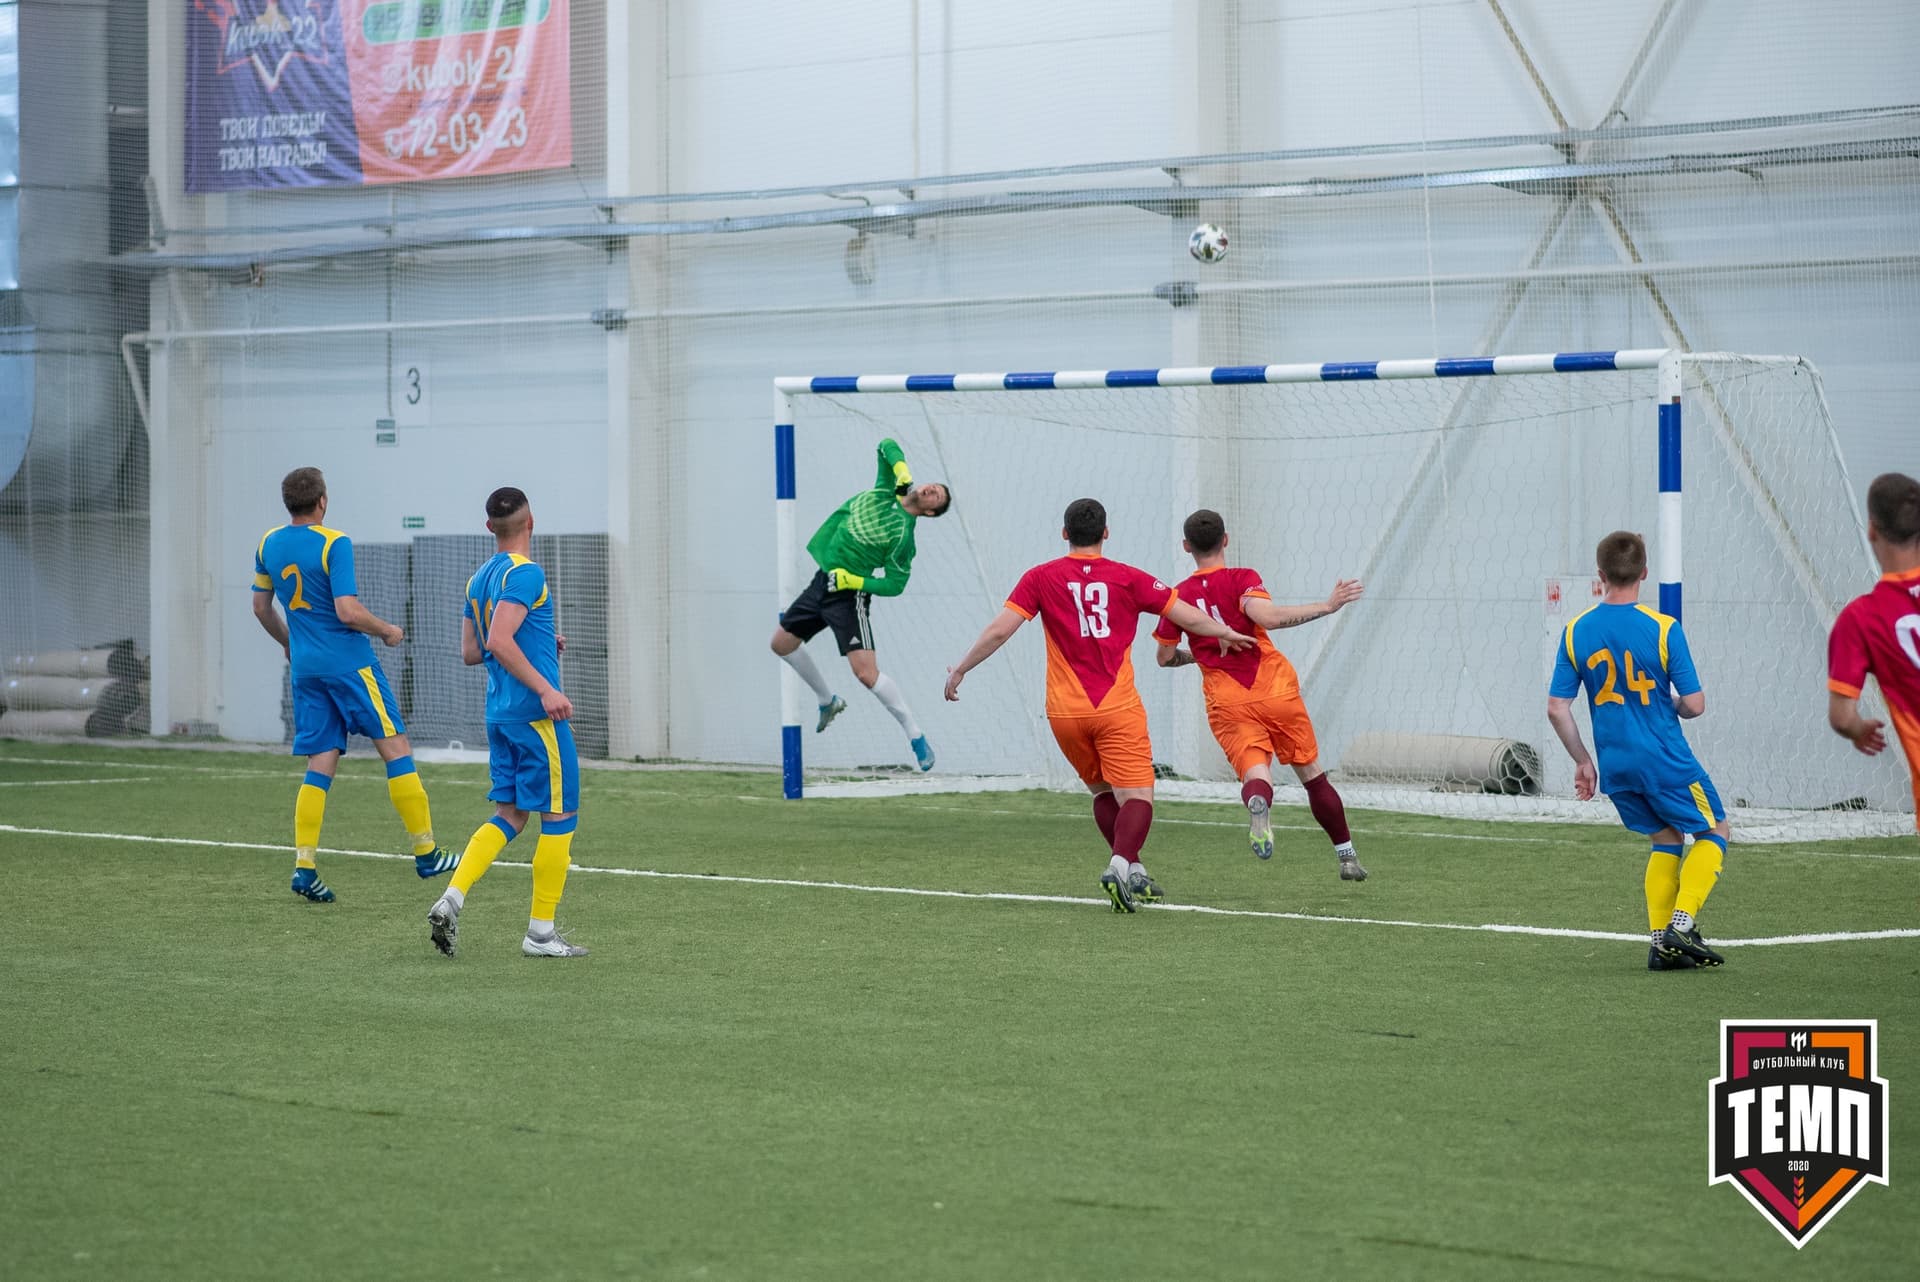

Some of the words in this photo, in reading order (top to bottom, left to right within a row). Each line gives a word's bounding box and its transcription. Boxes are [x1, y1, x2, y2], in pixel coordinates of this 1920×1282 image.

[407, 106, 528, 157] 72-03-23
[219, 146, 256, 171] ТВОИ
[406, 367, 421, 405] 3
[281, 563, 313, 611] 2
[1067, 582, 1111, 638] 13
[1586, 647, 1656, 706] 24
